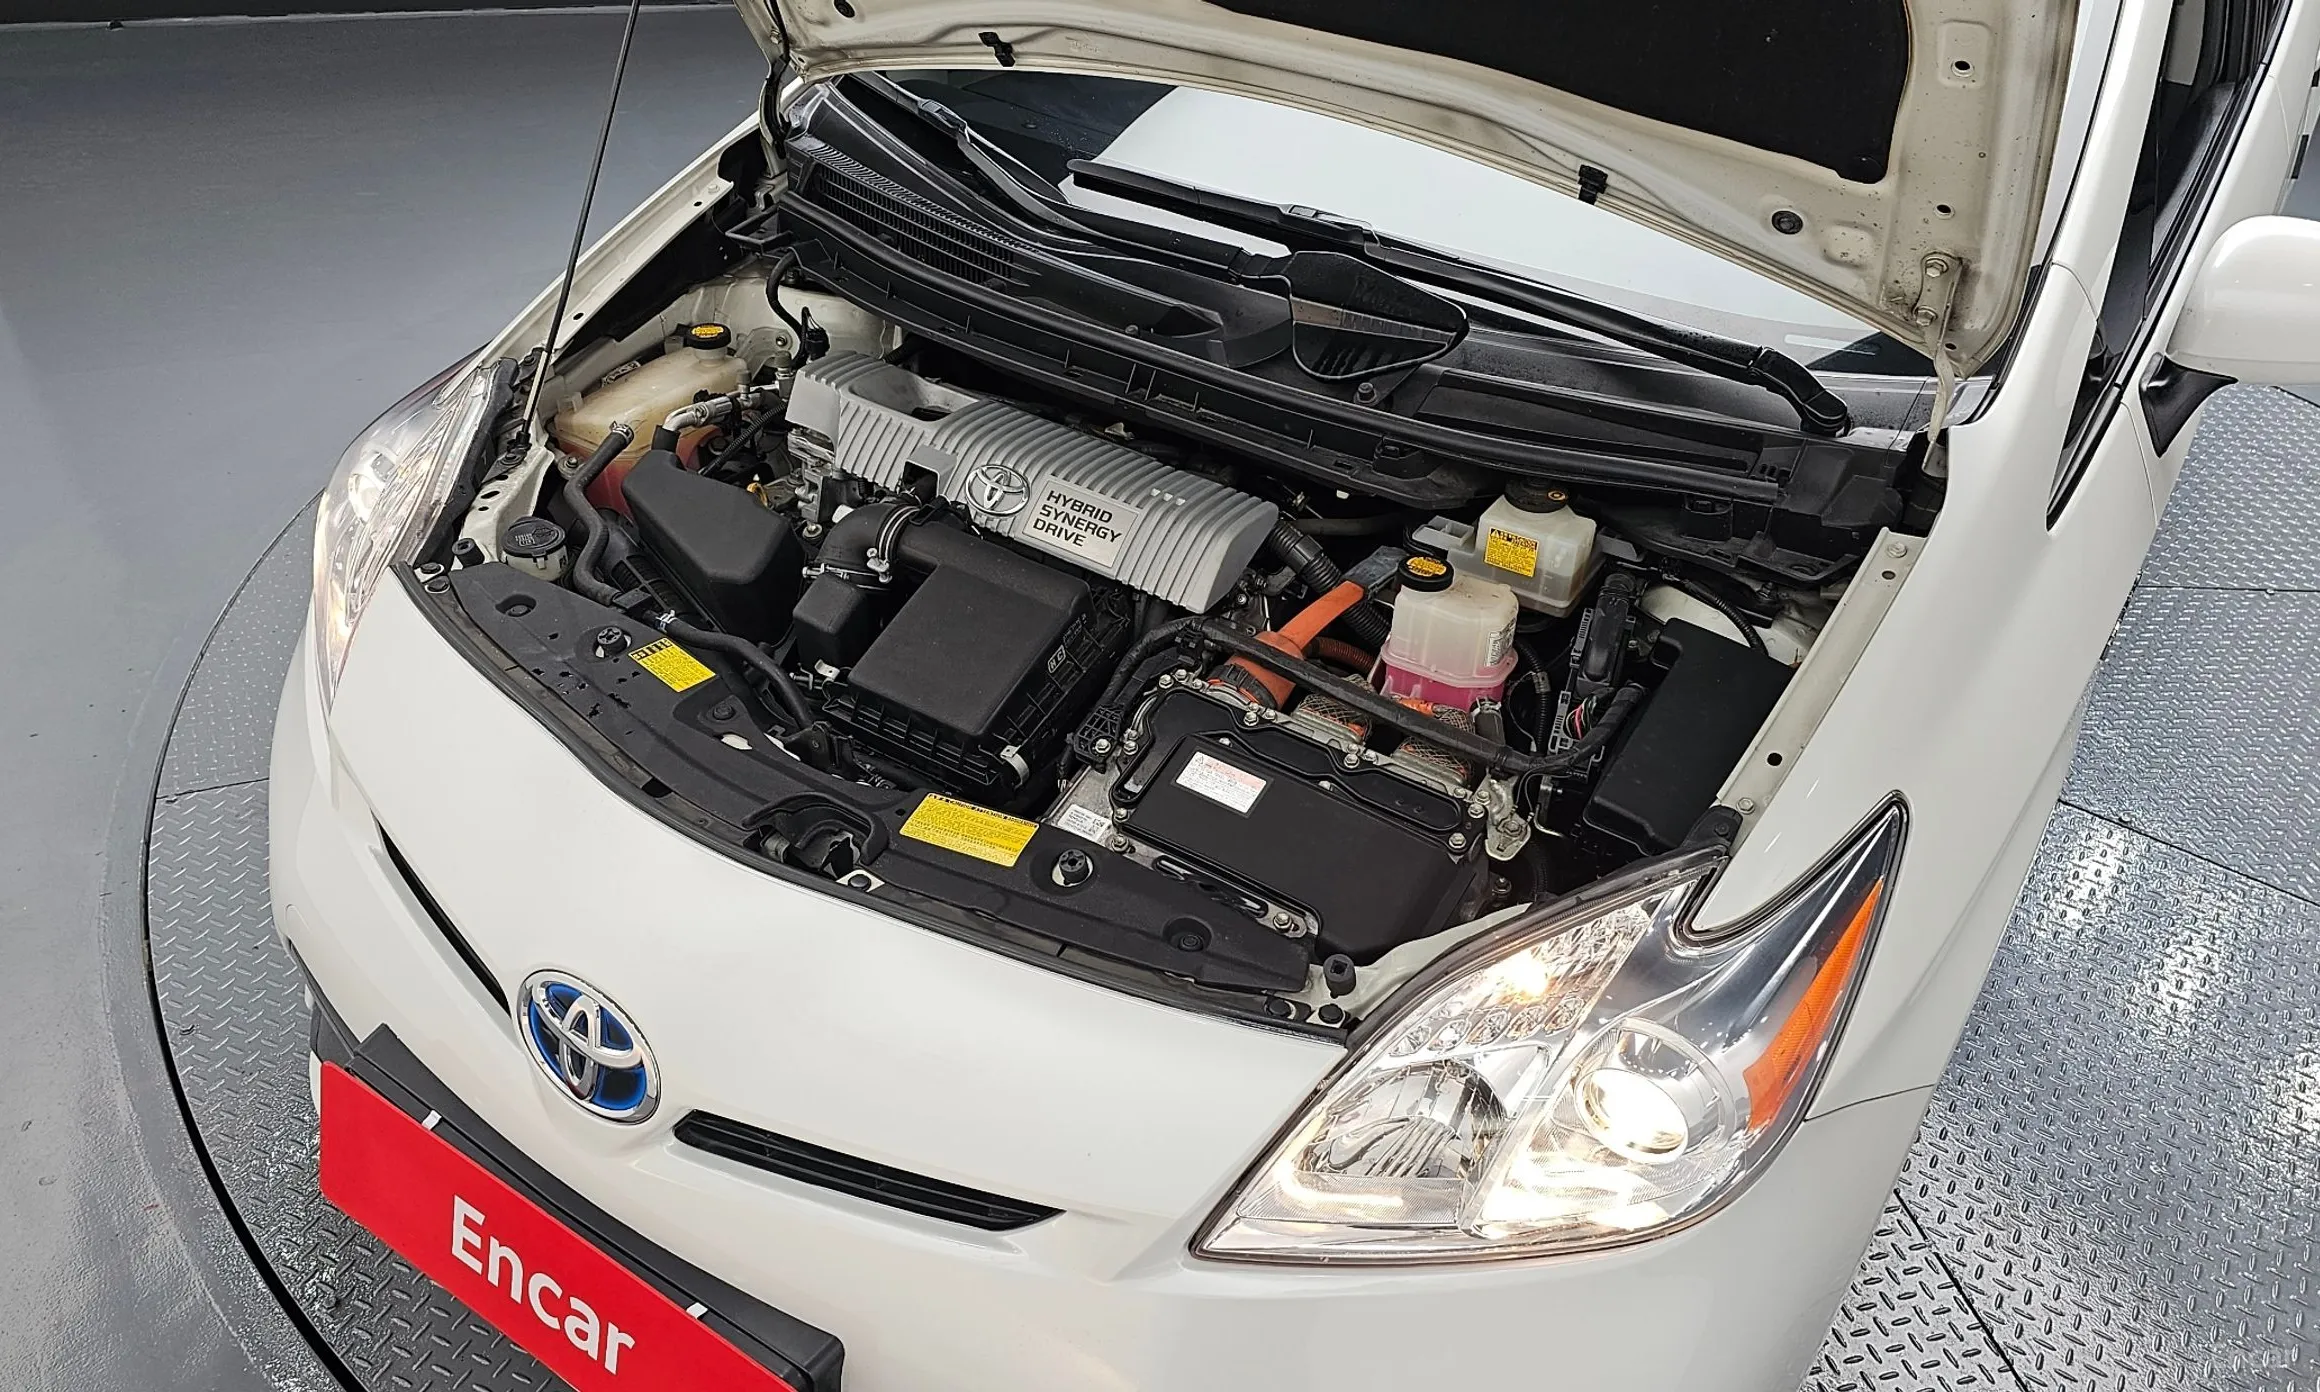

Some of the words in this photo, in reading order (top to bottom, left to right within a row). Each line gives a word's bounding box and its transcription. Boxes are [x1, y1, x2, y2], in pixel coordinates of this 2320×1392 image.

[1039, 504, 1122, 543] SYNERGY
[1046, 490, 1113, 523] HYBRID
[1033, 518, 1087, 547] DRIVE
[452, 1195, 636, 1375] Encar
